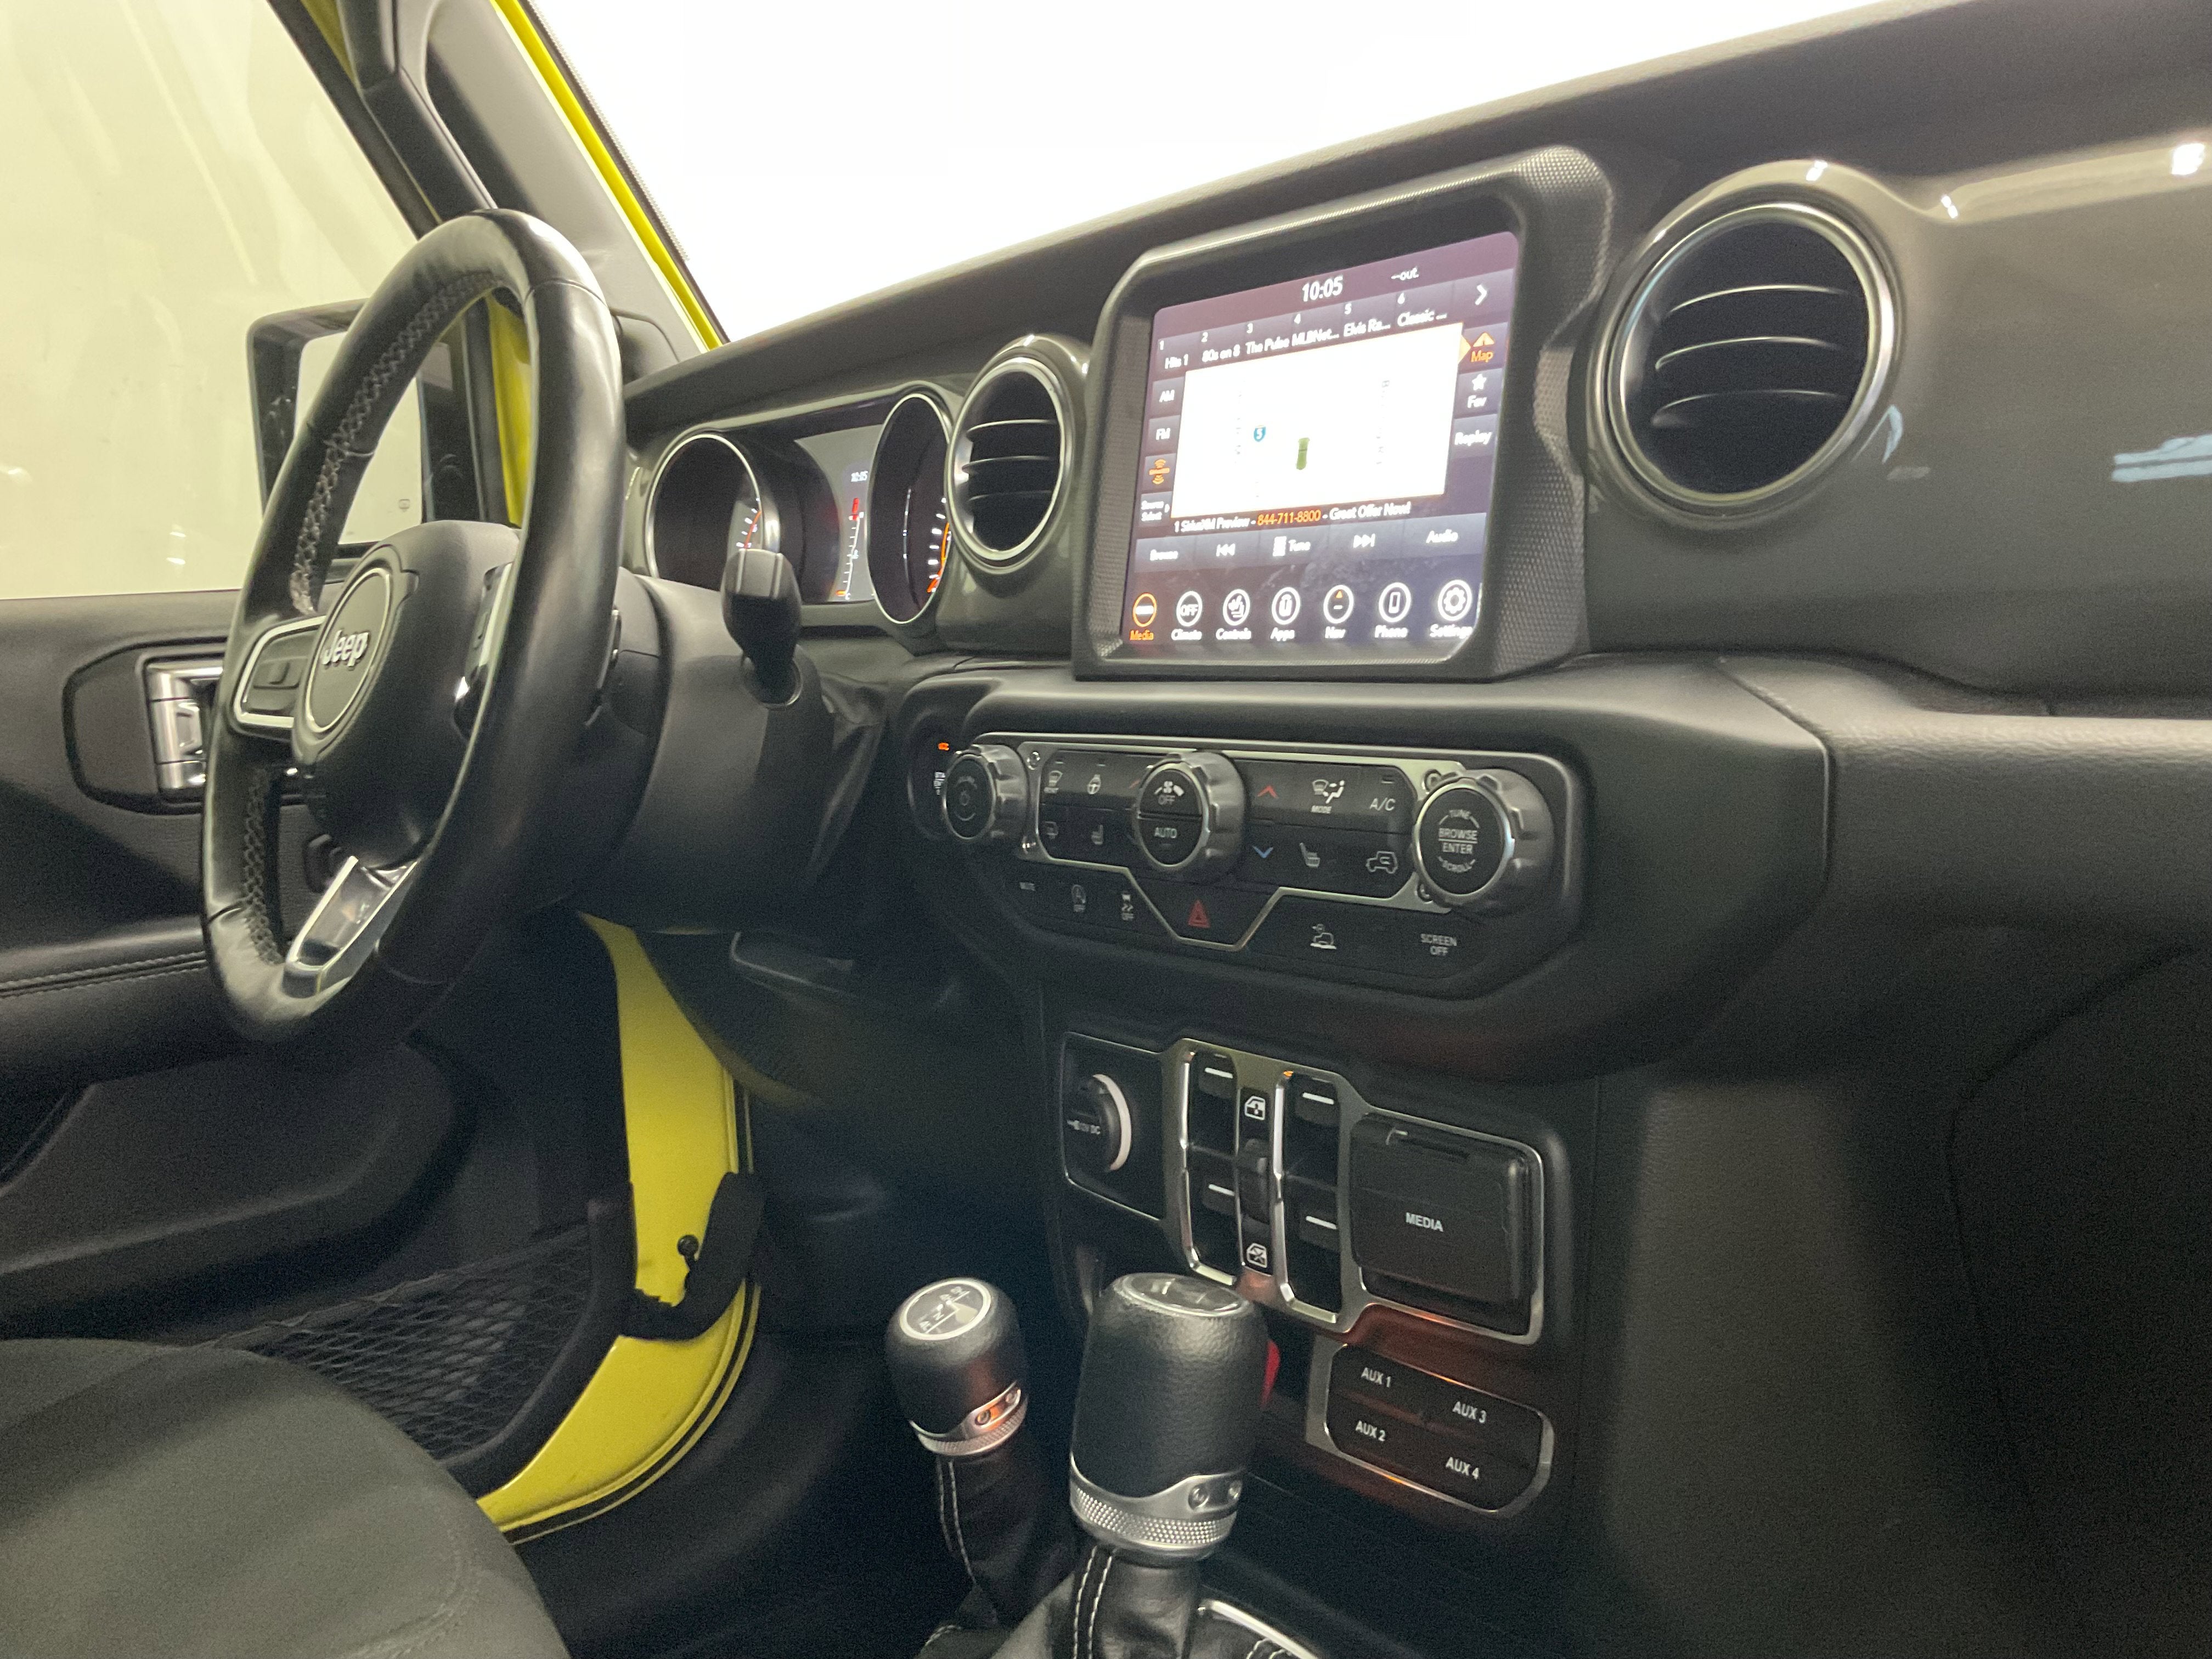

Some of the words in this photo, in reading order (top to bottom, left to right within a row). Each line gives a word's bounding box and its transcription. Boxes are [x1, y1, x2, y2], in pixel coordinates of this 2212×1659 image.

[1302, 274, 1343, 302] 10:05
[1397, 292, 1405, 304] 6
[1345, 303, 1352, 314] 5
[1294, 313, 1301, 324] 4
[1397, 308, 1435, 326] Classic
[1246, 323, 1253, 334] 3
[1344, 321, 1366, 337] Elvis
[1201, 332, 1209, 342] 2
[1159, 340, 1164, 350] 1
[1245, 341, 1263, 354] The
[1264, 336, 1289, 351] Pulse
[1183, 354, 1189, 366] 1
[1471, 350, 1493, 363] Map
[1159, 390, 1175, 403] AM
[1468, 394, 1487, 408] Fav
[1156, 427, 1171, 440] FM
[1454, 430, 1492, 447] Replay
[1257, 509, 1322, 526] 844-711-8800
[1329, 506, 1357, 520] Great
[1358, 503, 1383, 518] Offer
[1384, 501, 1411, 516] Now!
[1426, 529, 1458, 543] Audio
[1270, 627, 1295, 641] Apps
[1325, 626, 1345, 639] Nav
[1374, 625, 1408, 639] Phone
[1430, 624, 1473, 639] Settings
[323, 630, 370, 667] Jeep
[1369, 797, 1396, 811] A/C
[1154, 827, 1177, 839] AUTO
[1439, 827, 1478, 840] BROWSE
[1443, 842, 1473, 854] ENTER
[1420, 933, 1458, 946] SCREEN
[1430, 945, 1448, 956] OFF
[1406, 1212, 1444, 1232] MEDIA
[1361, 1367, 1384, 1385] AUX
[1386, 1376, 1391, 1387] 1
[1452, 1401, 1477, 1420] AUX
[1479, 1410, 1486, 1424] 3
[1355, 1420, 1378, 1438] AUX
[1378, 1430, 1386, 1442] 2
[1446, 1457, 1470, 1476] AUX
[1471, 1467, 1480, 1480] 4
